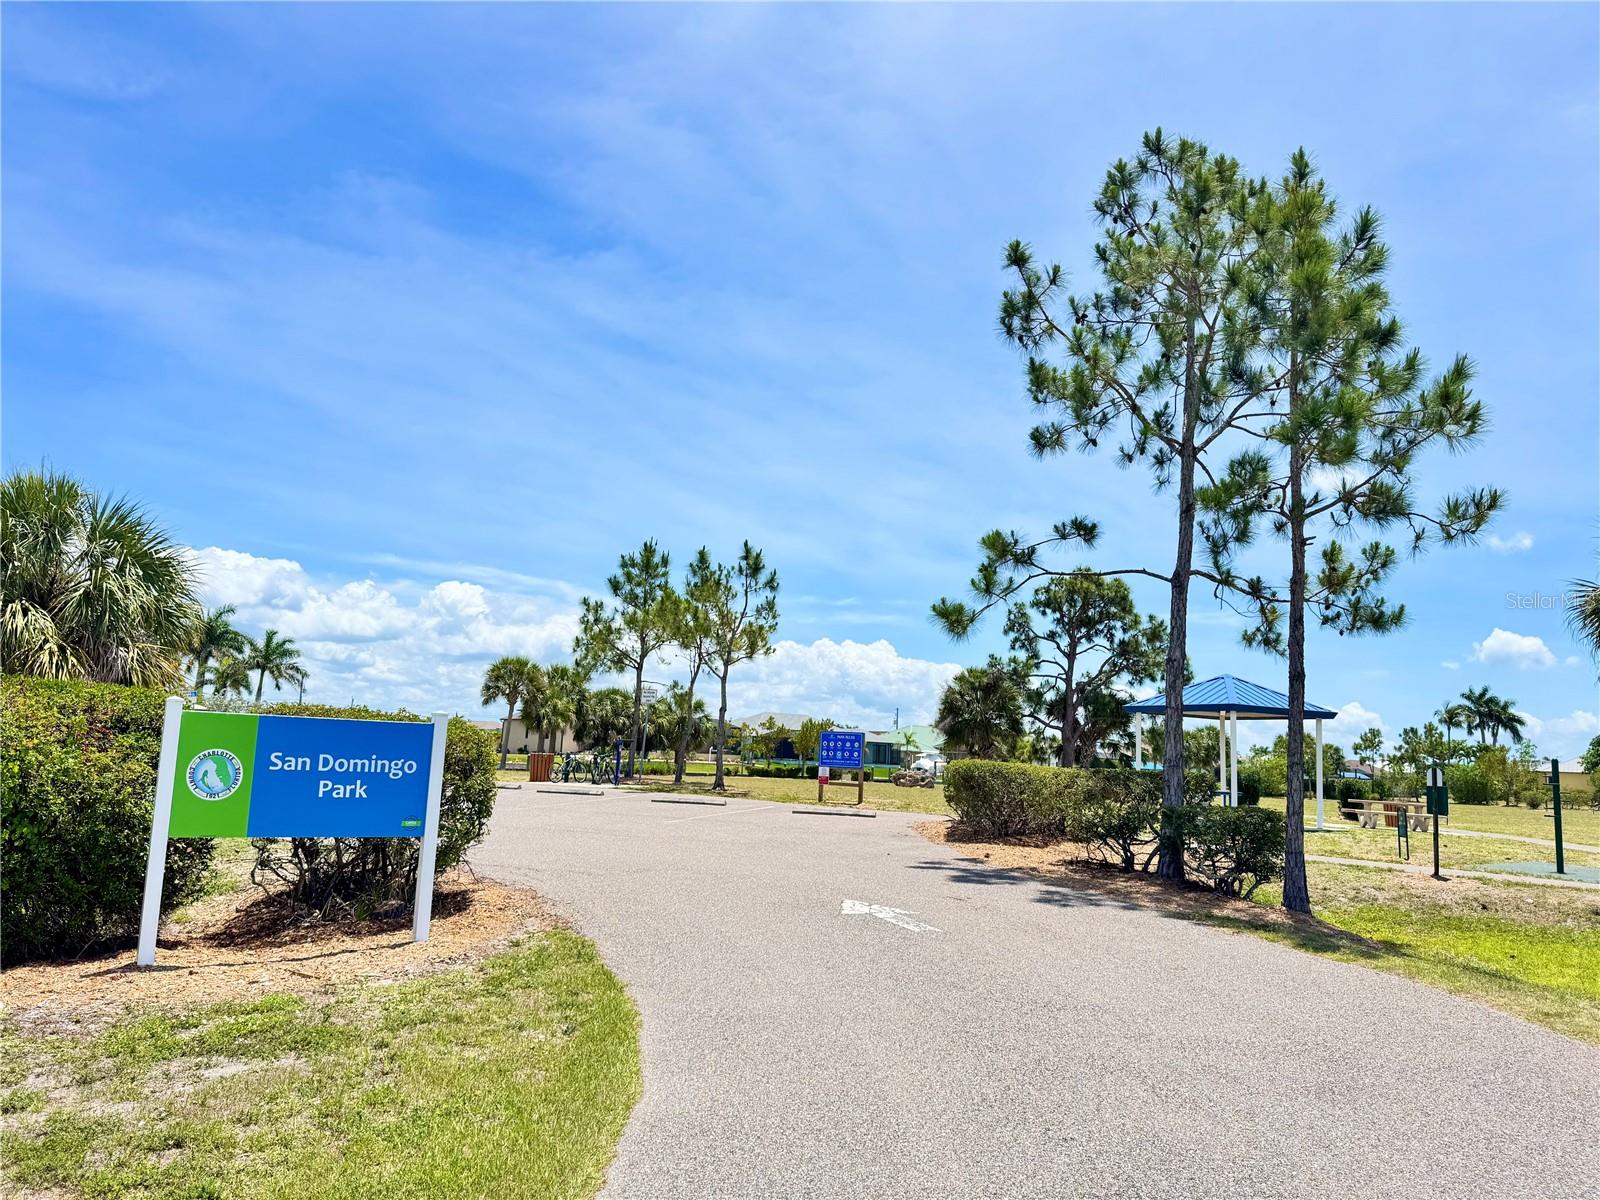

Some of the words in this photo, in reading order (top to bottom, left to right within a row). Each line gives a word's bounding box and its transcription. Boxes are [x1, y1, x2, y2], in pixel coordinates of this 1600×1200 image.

[198, 750, 235, 761] CHARLOTTE
[268, 752, 312, 772] San
[317, 754, 418, 780] Domingo
[188, 766, 199, 791] COUNTY
[228, 766, 242, 793] FLORIDA
[318, 780, 368, 799] Park
